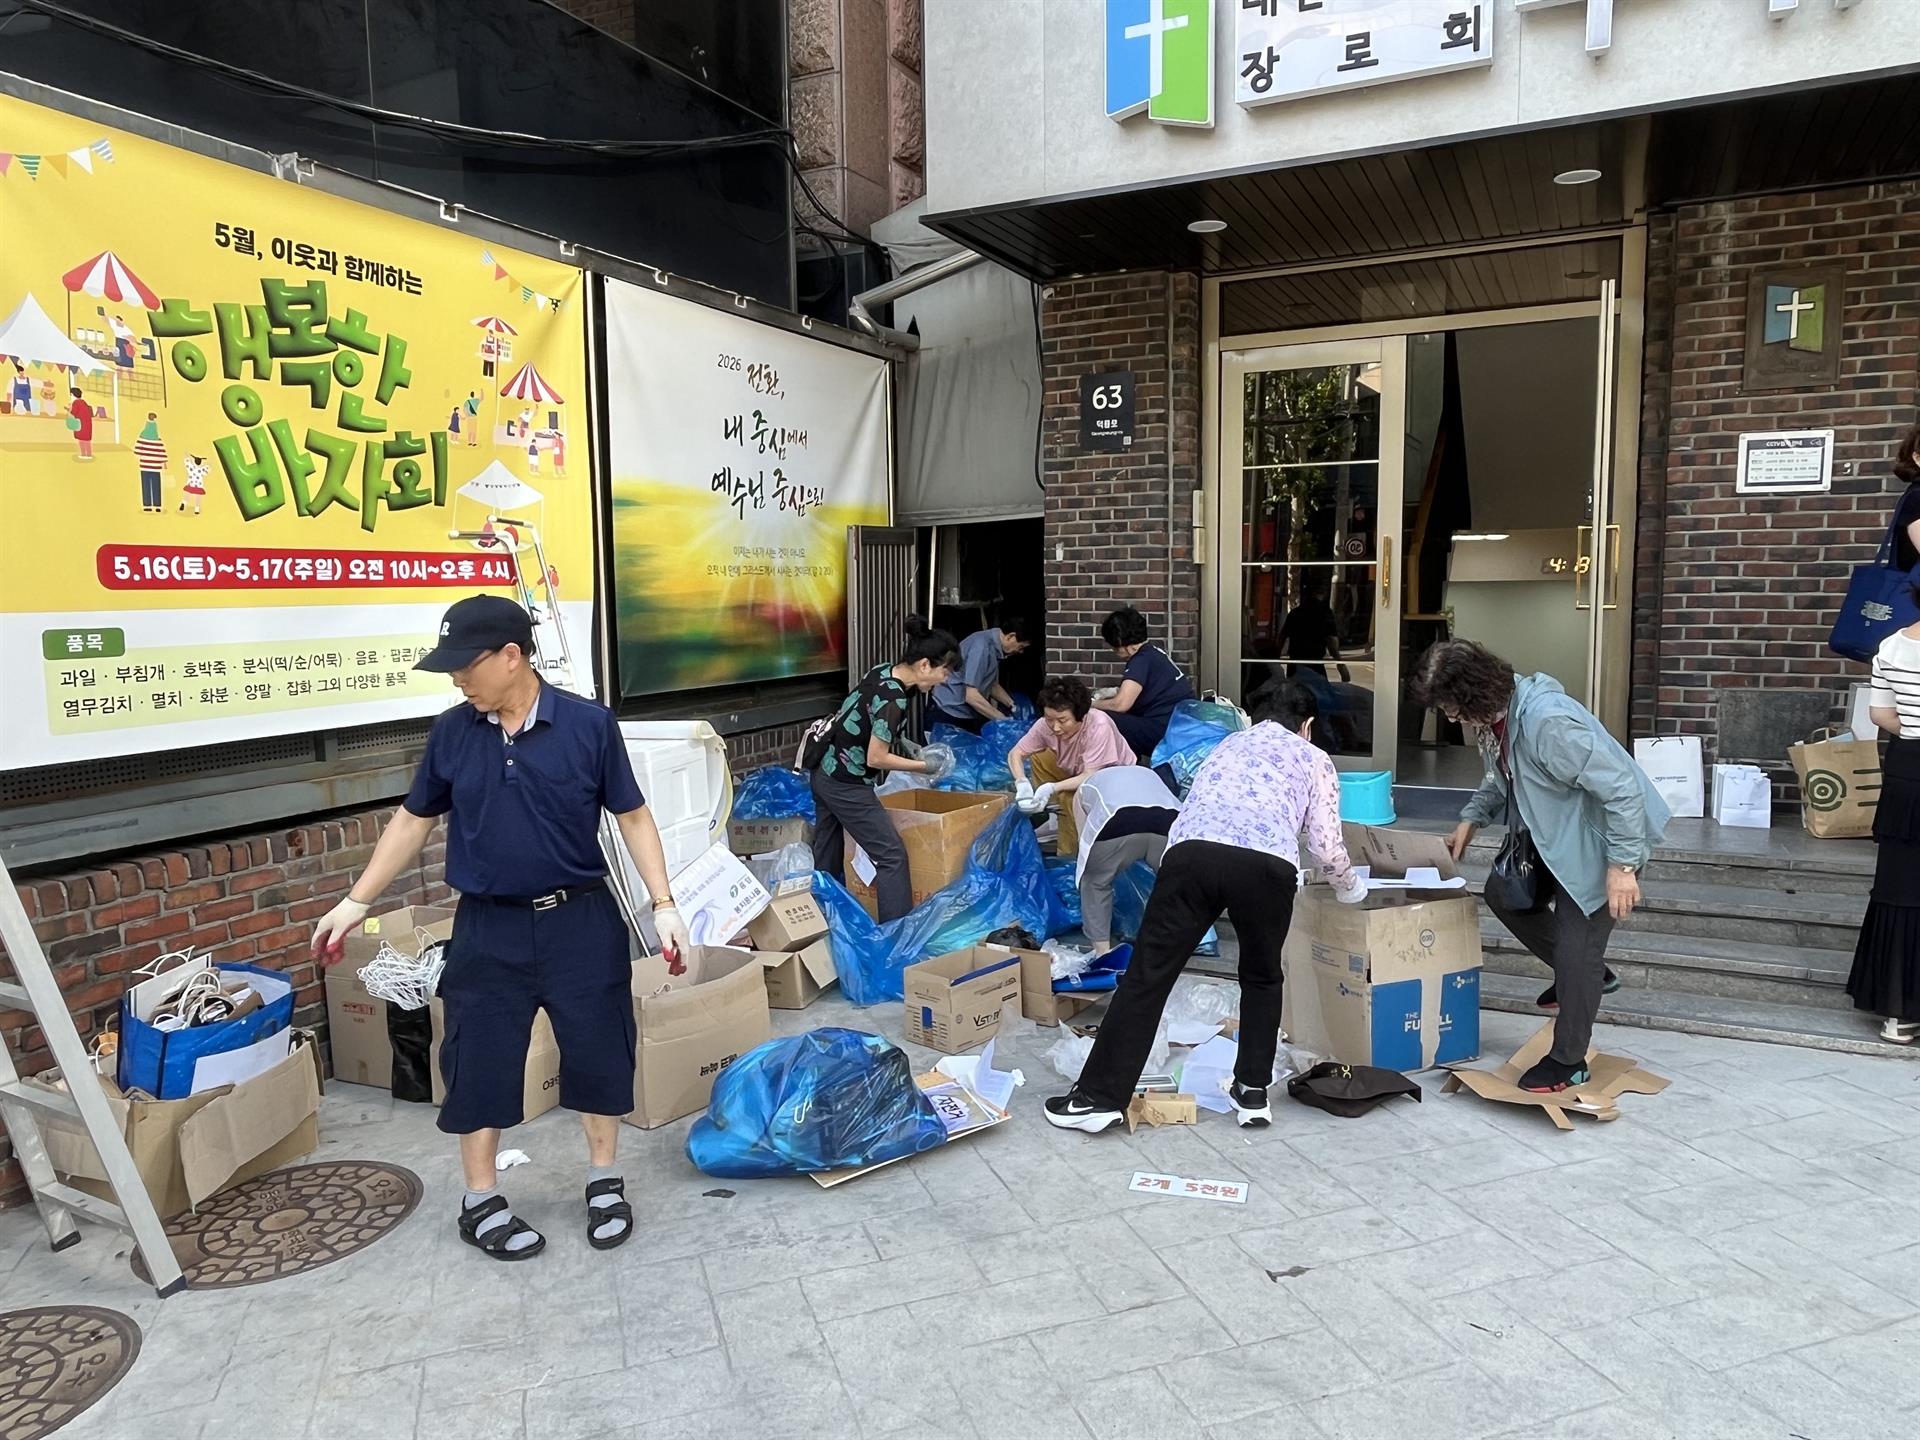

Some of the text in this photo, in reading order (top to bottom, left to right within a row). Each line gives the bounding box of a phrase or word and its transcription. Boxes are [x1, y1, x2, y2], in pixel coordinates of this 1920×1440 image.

[214, 222, 423, 295] 5월, 이웃과 함께하는
[147, 277, 411, 432] 행복한
[717, 353, 742, 372] 2026
[1092, 385, 1123, 410] 63
[724, 410, 808, 460] 내 중심에서
[213, 418, 448, 533] 바자회
[712, 466, 766, 520] 예수님
[114, 556, 510, 581] 5.16(토)~5.17(주일) 오전 10시~오후 4시
[65, 634, 104, 652] 품목
[60, 668, 96, 687] 과일
[115, 664, 165, 684] 부침개
[183, 660, 227, 678] 호박죽
[242, 652, 343, 674] 분식(떡/순/어묵)
[356, 650, 379, 666] 음료
[63, 671, 407, 717] 열무김치 멸치 화분 양말 잡화 그외 다양한 품목
[1137, 1177, 1239, 1198] 2개 5천원
